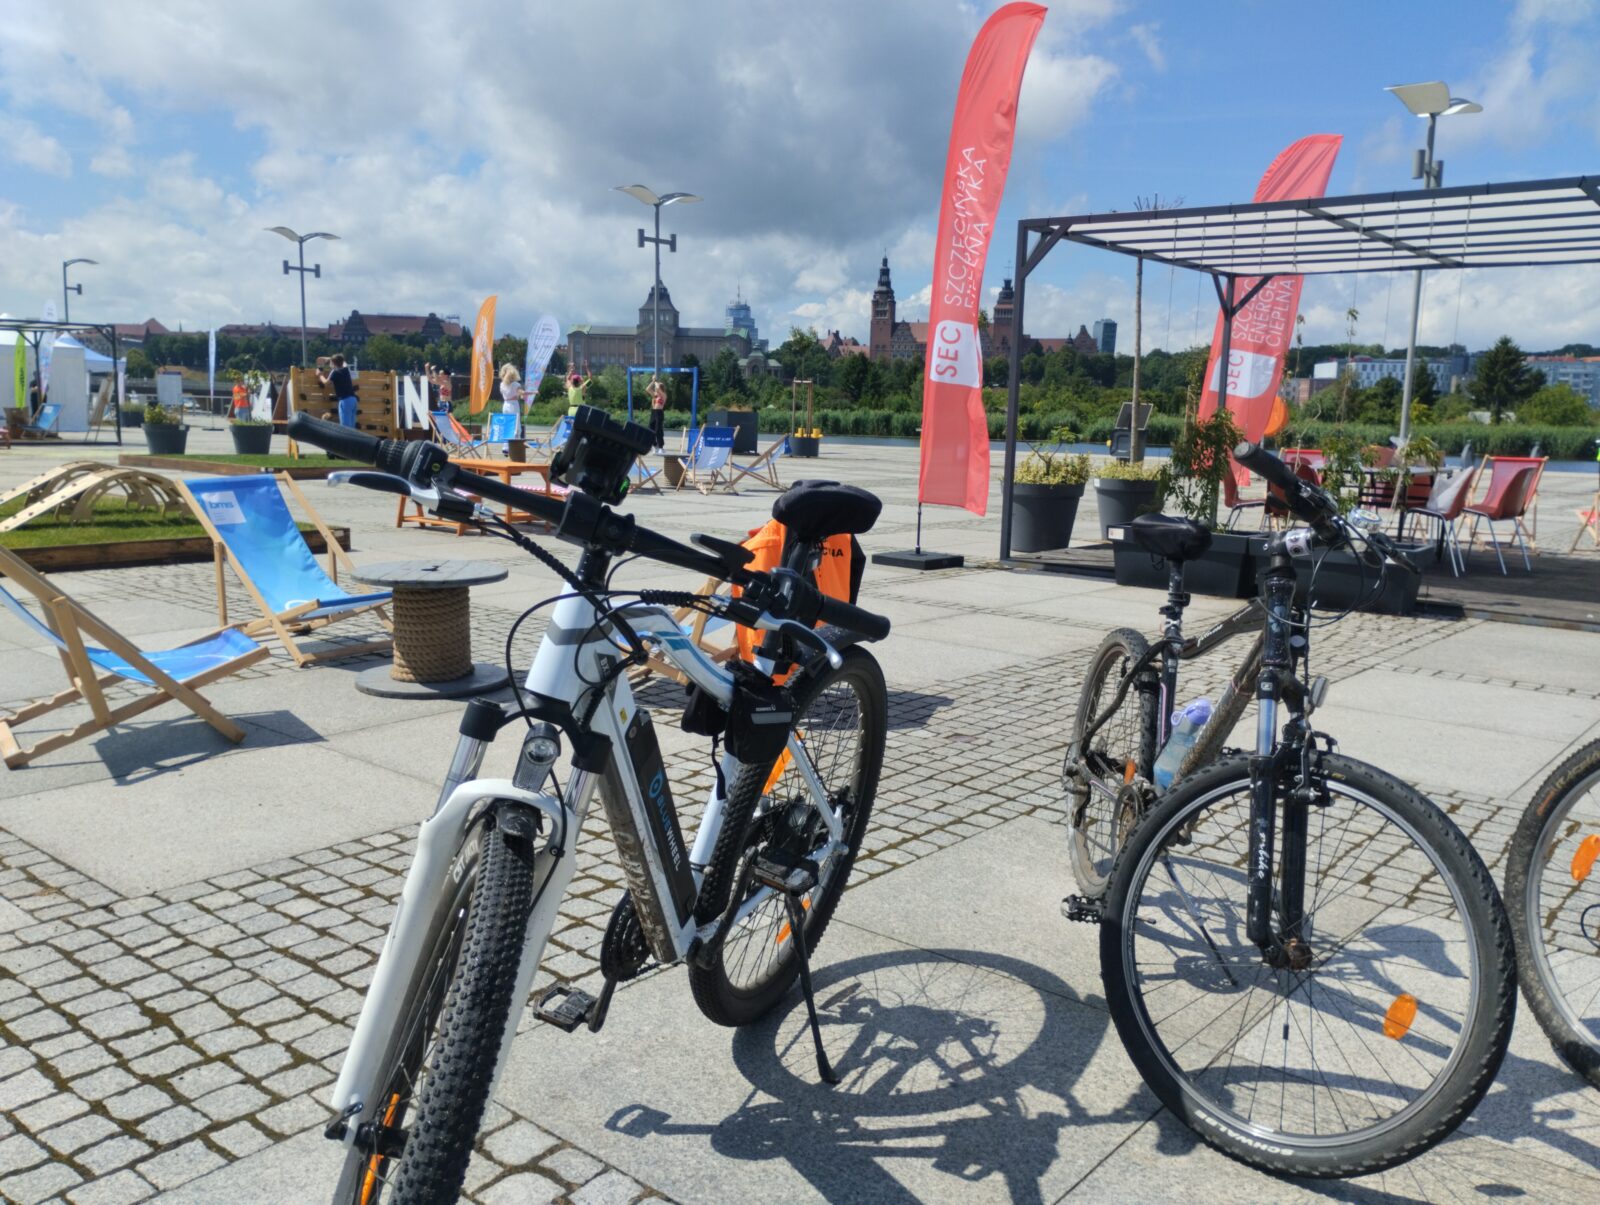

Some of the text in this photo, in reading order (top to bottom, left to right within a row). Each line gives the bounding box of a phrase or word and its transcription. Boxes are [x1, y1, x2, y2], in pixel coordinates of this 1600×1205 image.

[1265, 280, 1296, 347] CIEPLNA
[936, 325, 961, 377] SEC
[1226, 354, 1244, 390] SEC
[657, 794, 681, 872] BLUEWHEEL
[1194, 1109, 1295, 1156] SCHWALBE
